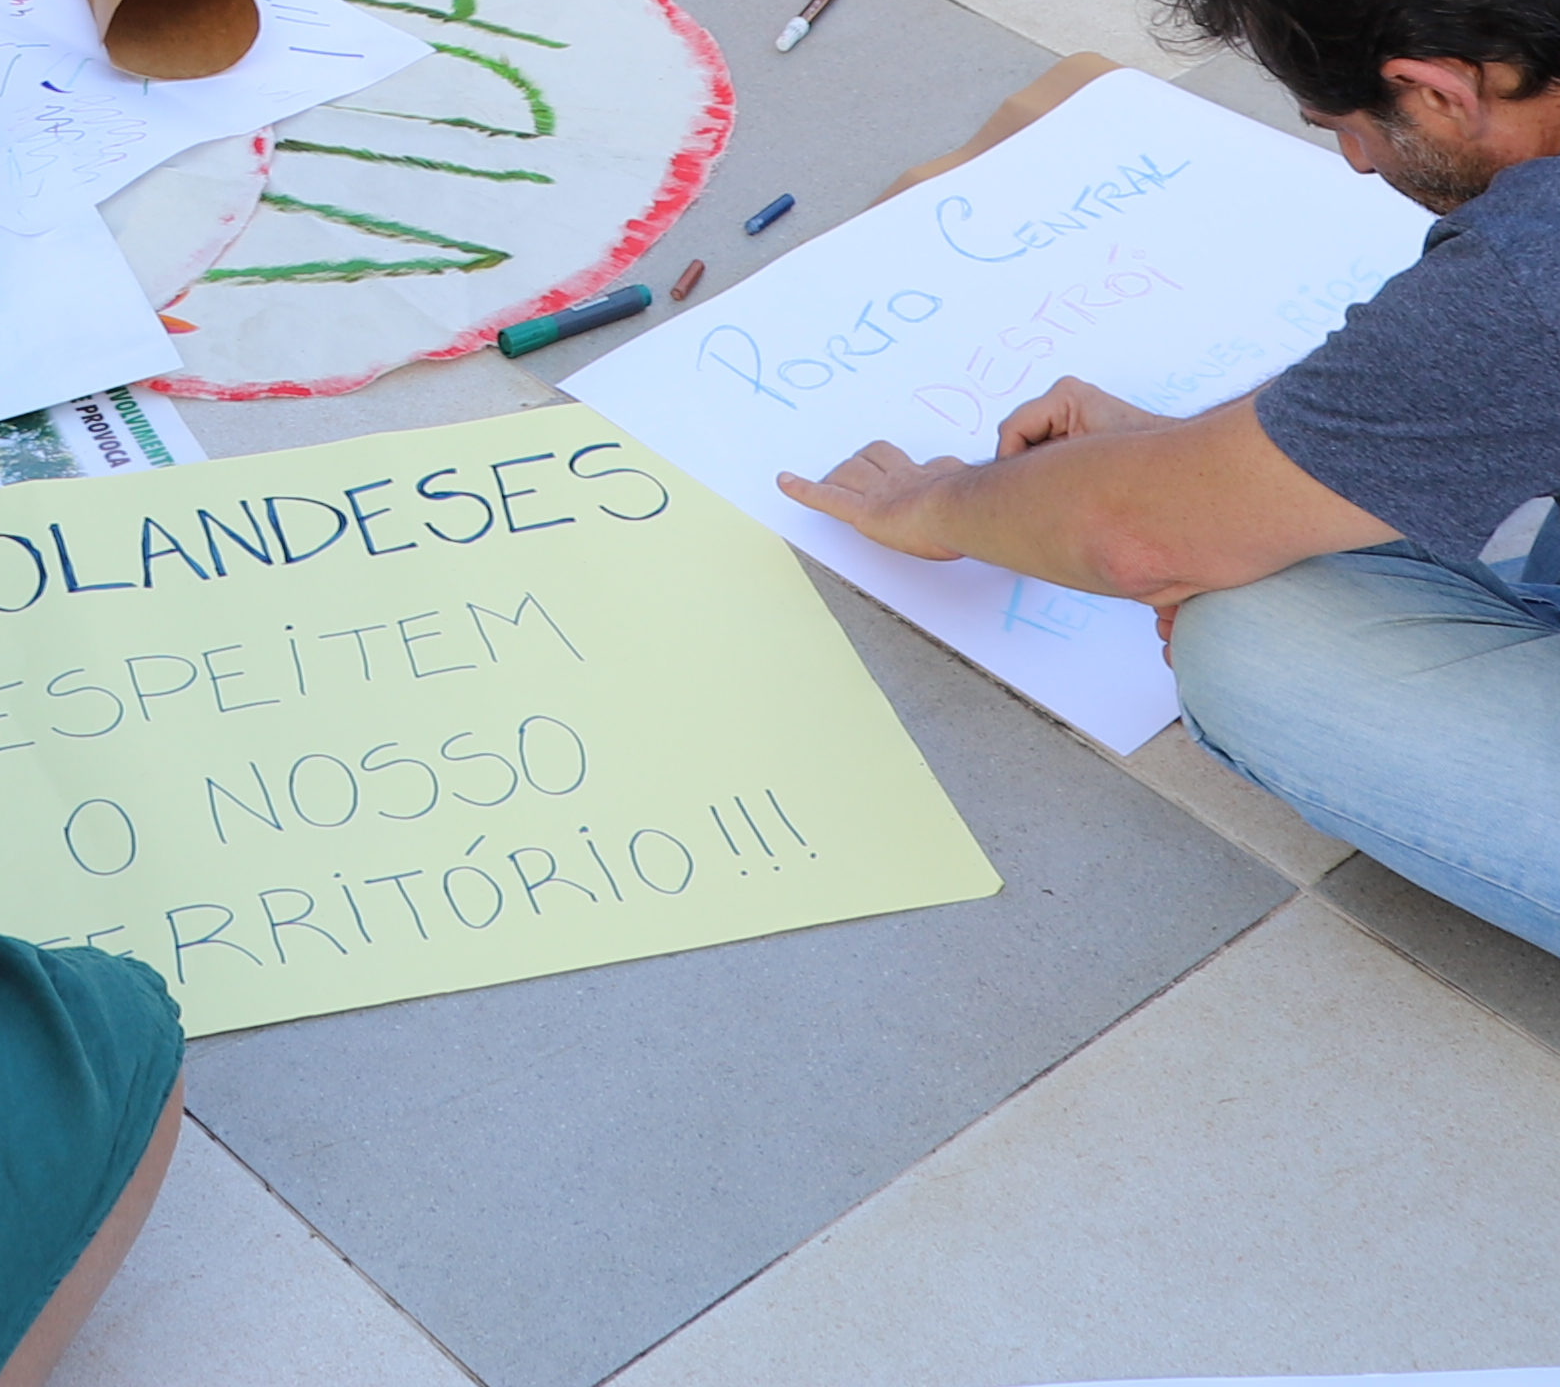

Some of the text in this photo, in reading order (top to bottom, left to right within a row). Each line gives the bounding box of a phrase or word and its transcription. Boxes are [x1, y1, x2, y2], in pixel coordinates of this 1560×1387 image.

[75, 404, 133, 469] PROVOCA
[63, 715, 588, 876] O NOSSO
